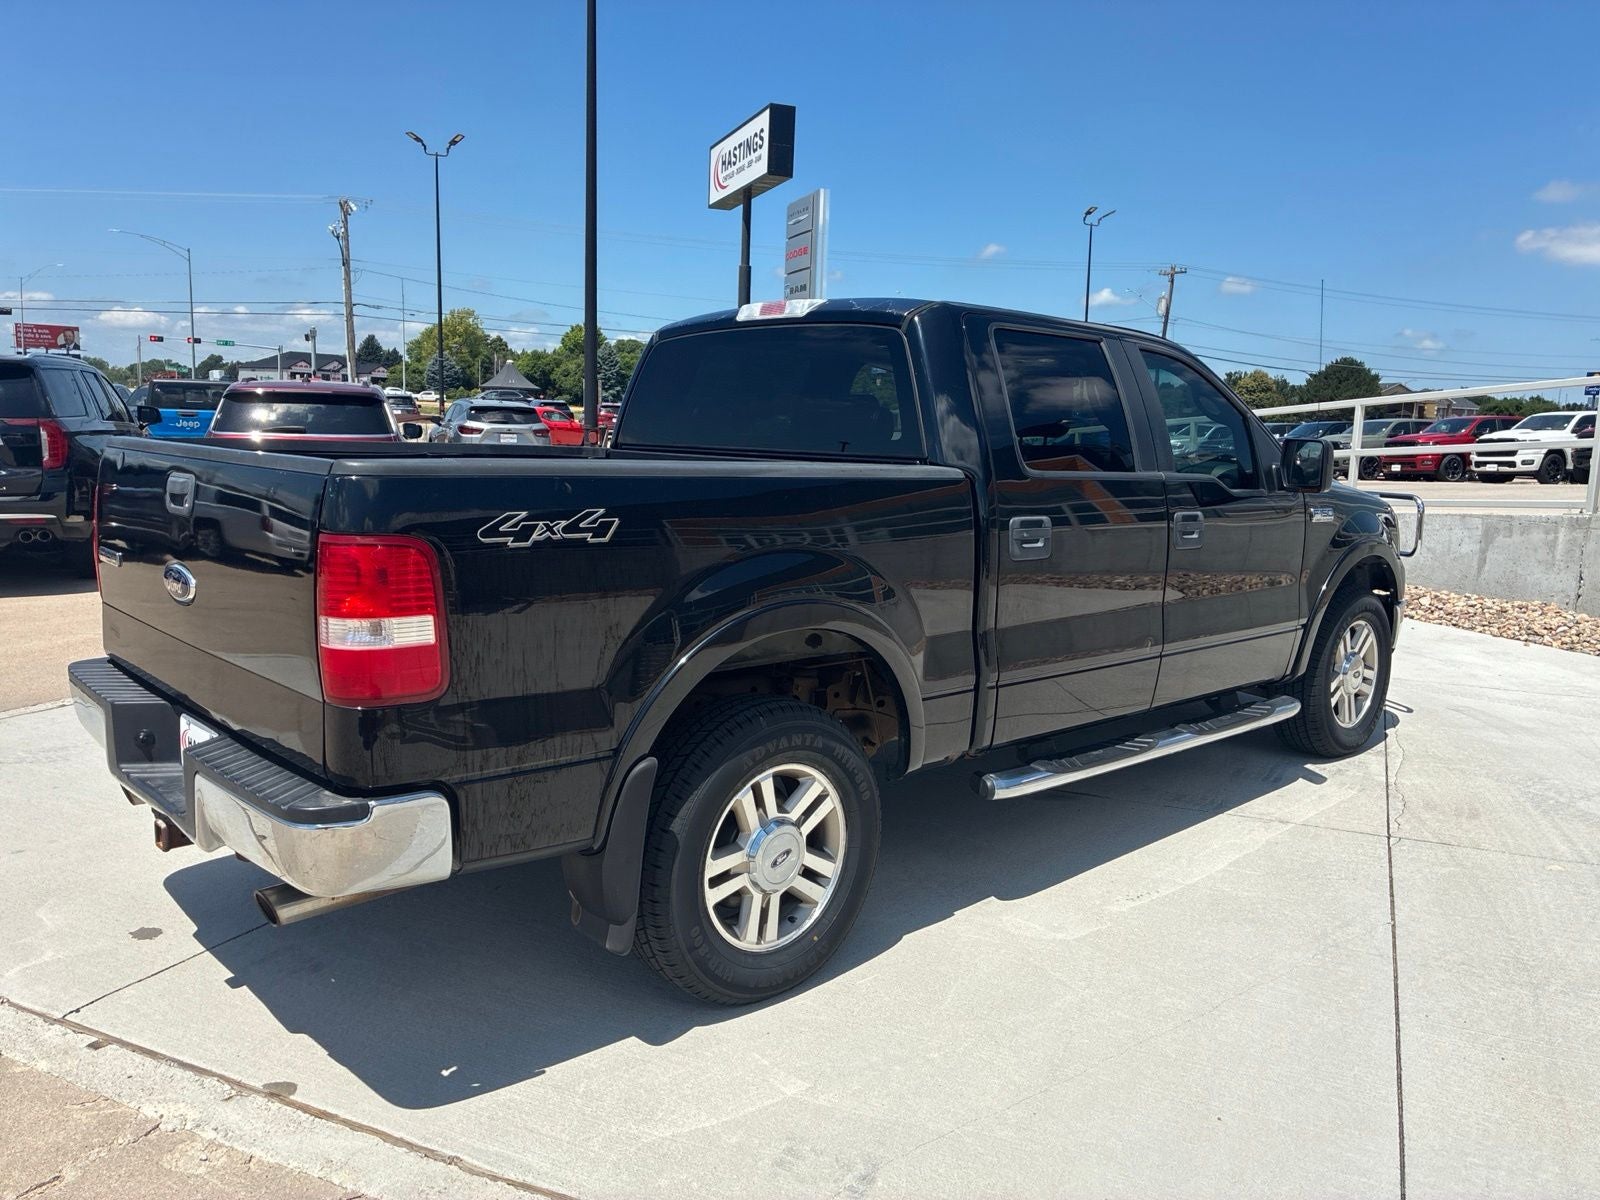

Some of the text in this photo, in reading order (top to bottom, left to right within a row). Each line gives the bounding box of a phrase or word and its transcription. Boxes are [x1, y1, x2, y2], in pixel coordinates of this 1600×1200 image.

[721, 127, 765, 174] HASTINGS
[786, 246, 809, 261] DODGE
[789, 283, 807, 295] RAM
[175, 419, 201, 429] Jeep
[477, 508, 620, 548] 4x4
[743, 733, 824, 771] ADVANTA
